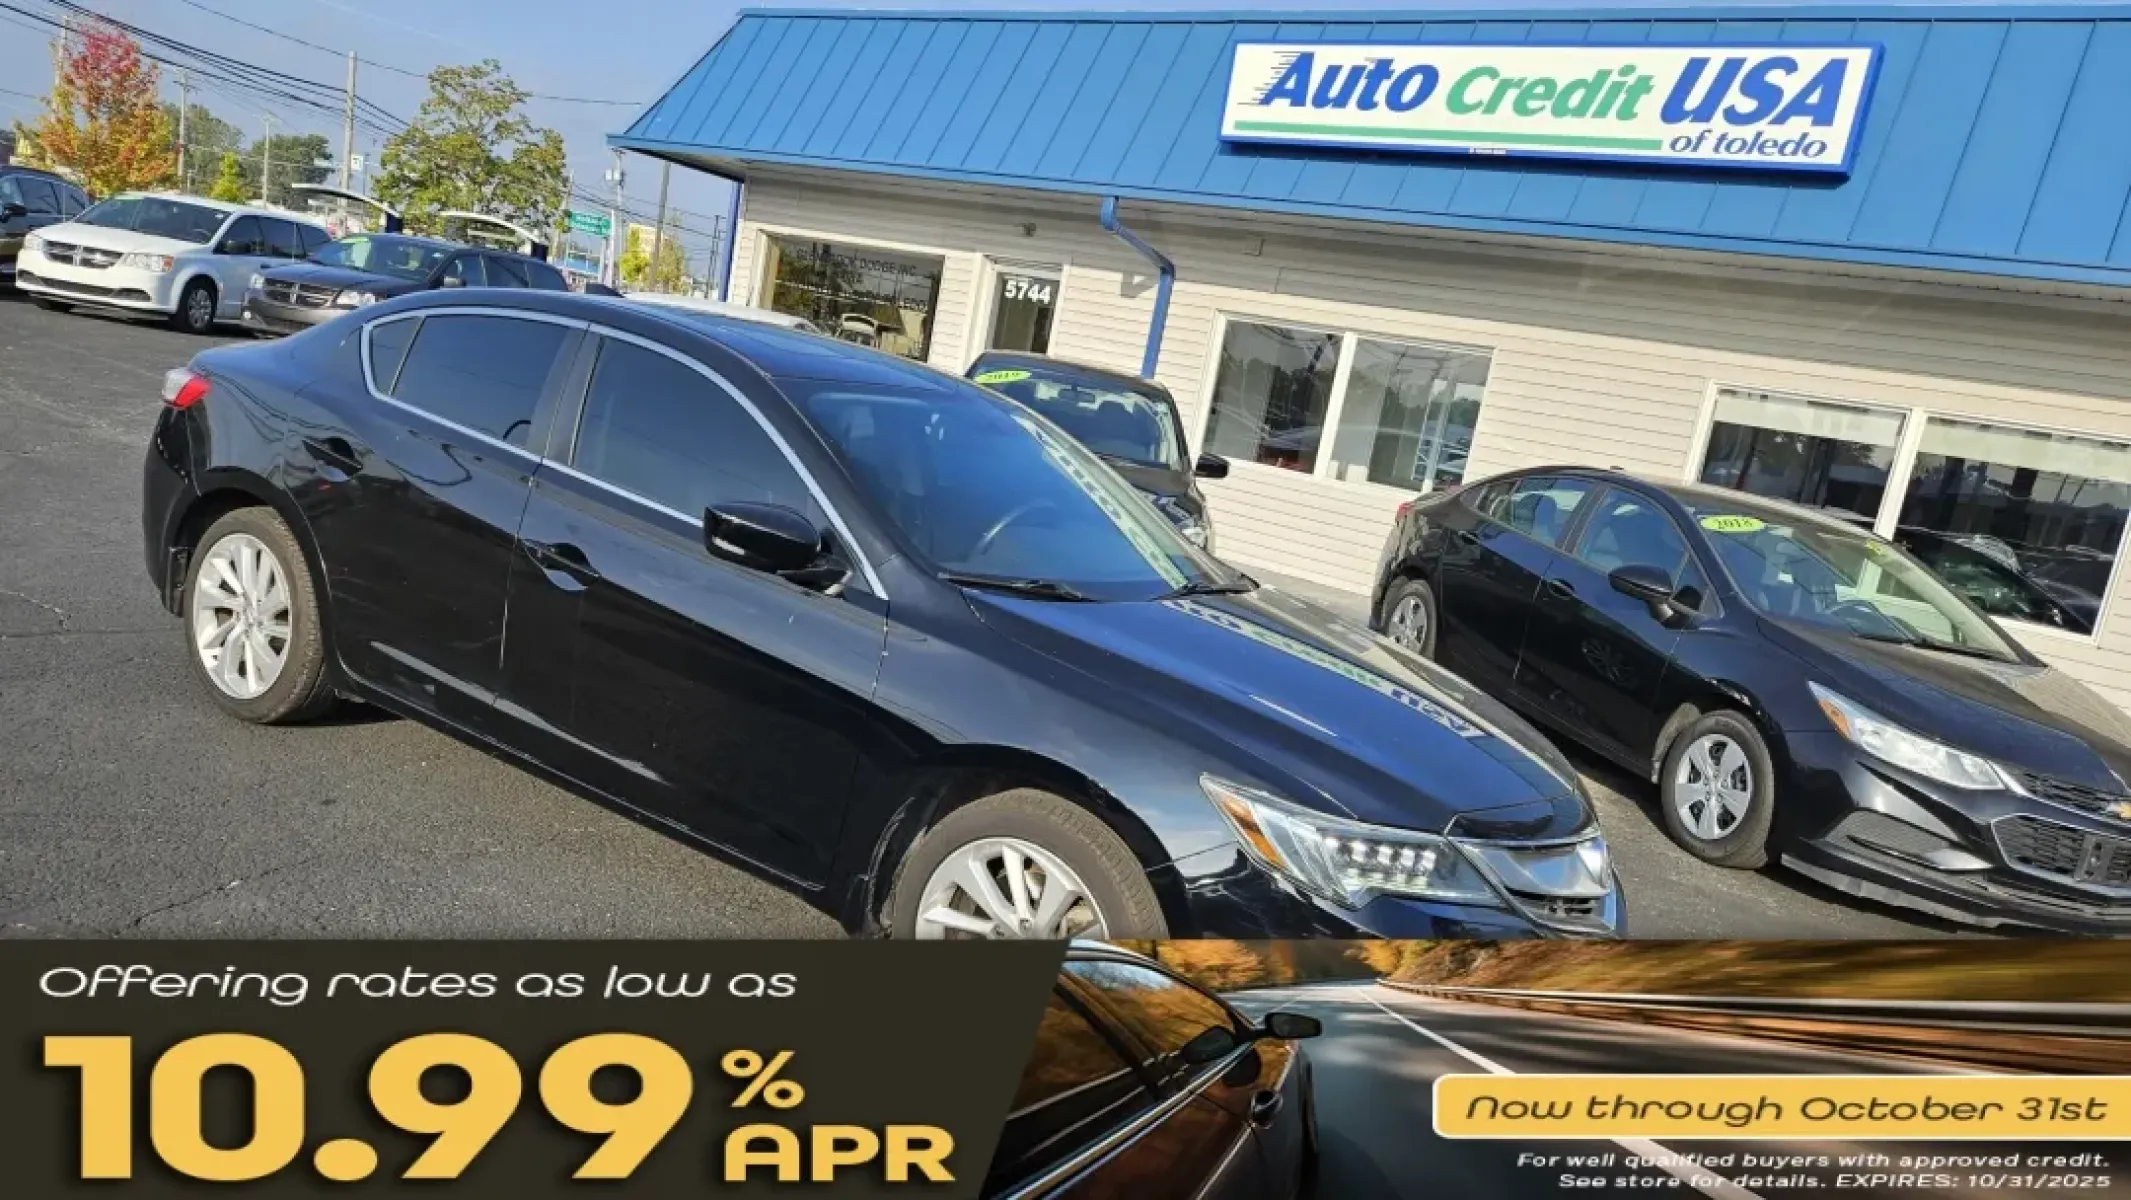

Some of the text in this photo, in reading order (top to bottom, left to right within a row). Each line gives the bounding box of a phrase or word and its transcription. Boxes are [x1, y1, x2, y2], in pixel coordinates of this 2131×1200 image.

[1259, 52, 1850, 127] Auto Credit USA
[1669, 129, 1828, 158] of toledo
[1003, 279, 1051, 305] 5744
